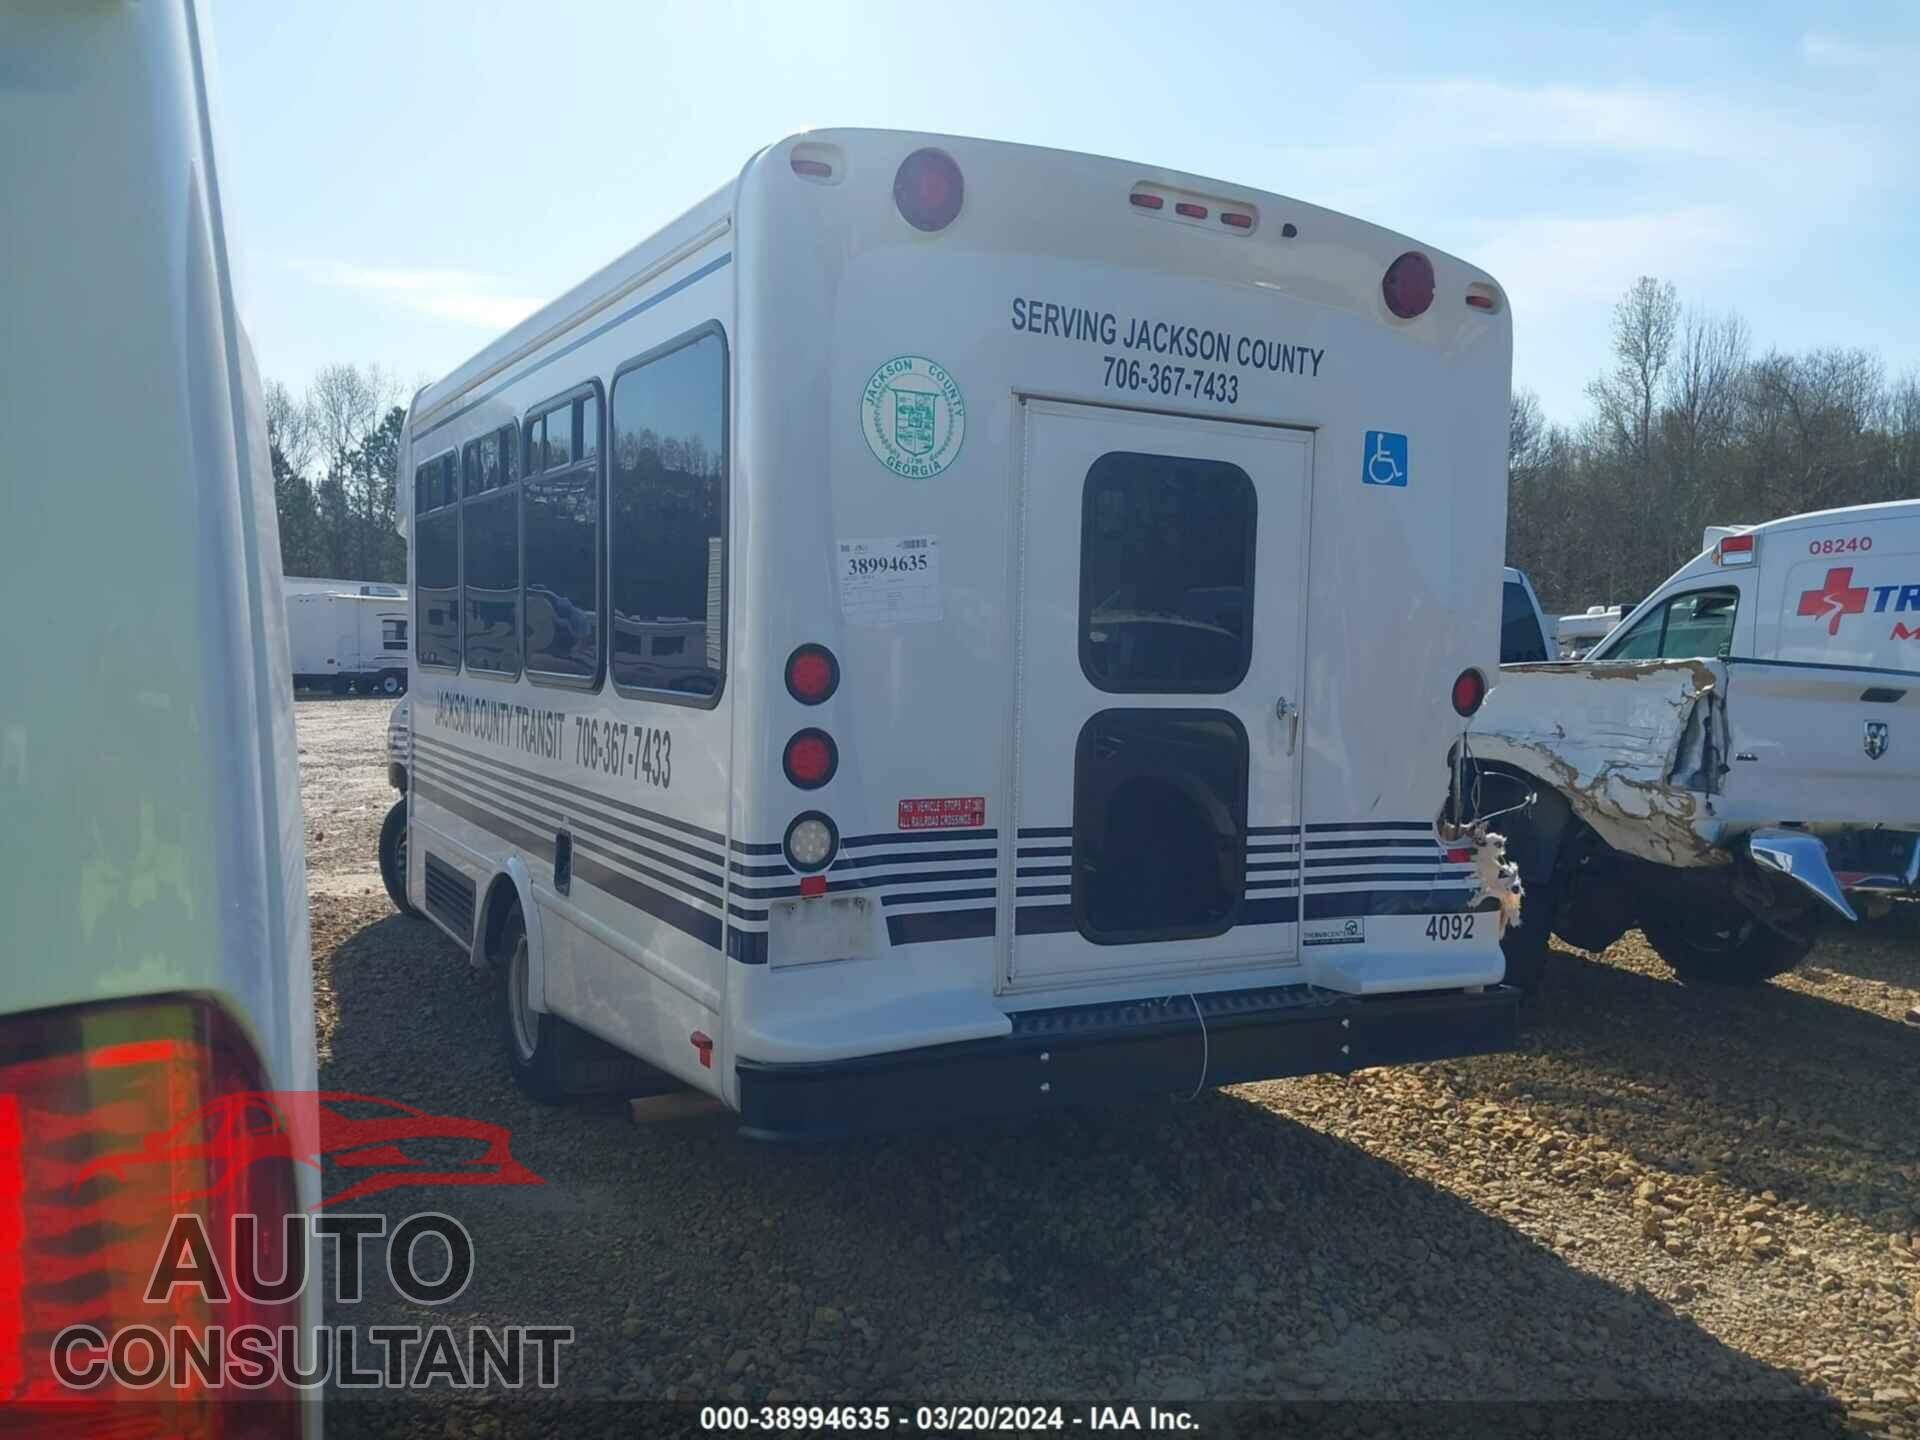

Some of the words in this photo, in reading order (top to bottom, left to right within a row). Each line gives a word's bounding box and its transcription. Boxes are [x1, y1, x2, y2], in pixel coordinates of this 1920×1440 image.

[1011, 297, 1117, 346] SERVING
[1123, 317, 1231, 364] JACKSON
[1236, 336, 1325, 377] COUNTY
[866, 359, 913, 405] JACKSON
[928, 364, 965, 417] COUNTY
[1102, 355, 1239, 405] 706-367-7433
[886, 455, 942, 476] GEORGIA
[848, 554, 928, 576] 38994635
[1808, 536, 1873, 555] 08240
[433, 687, 473, 734] JACKSON
[473, 697, 514, 748] COUNTY
[515, 704, 566, 761] TRANSIT
[575, 715, 672, 790] 706-367-7433
[1425, 914, 1475, 942] 4092
